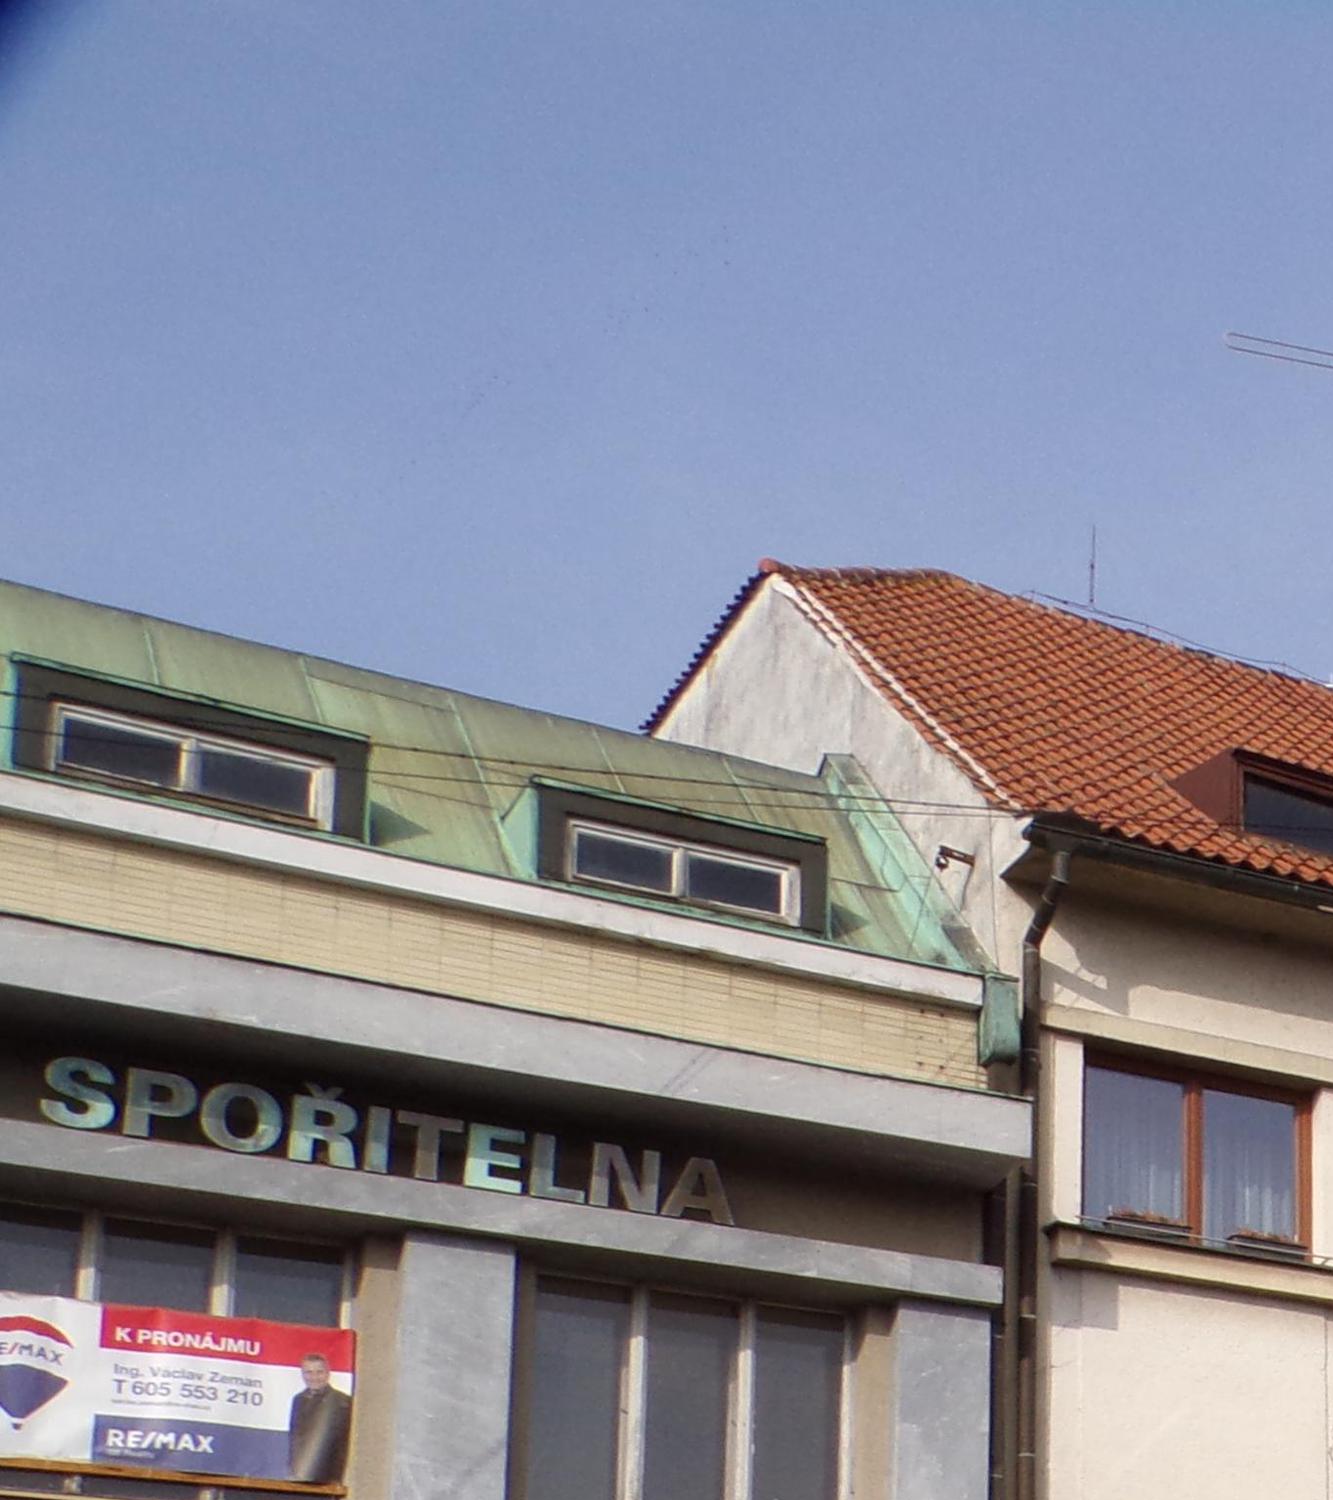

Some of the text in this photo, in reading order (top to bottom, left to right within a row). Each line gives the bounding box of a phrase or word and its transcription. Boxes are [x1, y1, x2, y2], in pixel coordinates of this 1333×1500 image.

[40, 1056, 734, 1226] SPOŘITELNA
[0, 1342, 63, 1366] E/MAX
[115, 1327, 261, 1356] K PRONÁJMU
[112, 1379, 126, 1394] T
[131, 1380, 171, 1397] 605
[178, 1383, 218, 1401] 553
[226, 1388, 264, 1407] 210
[105, 1428, 215, 1453] RE/MAX
